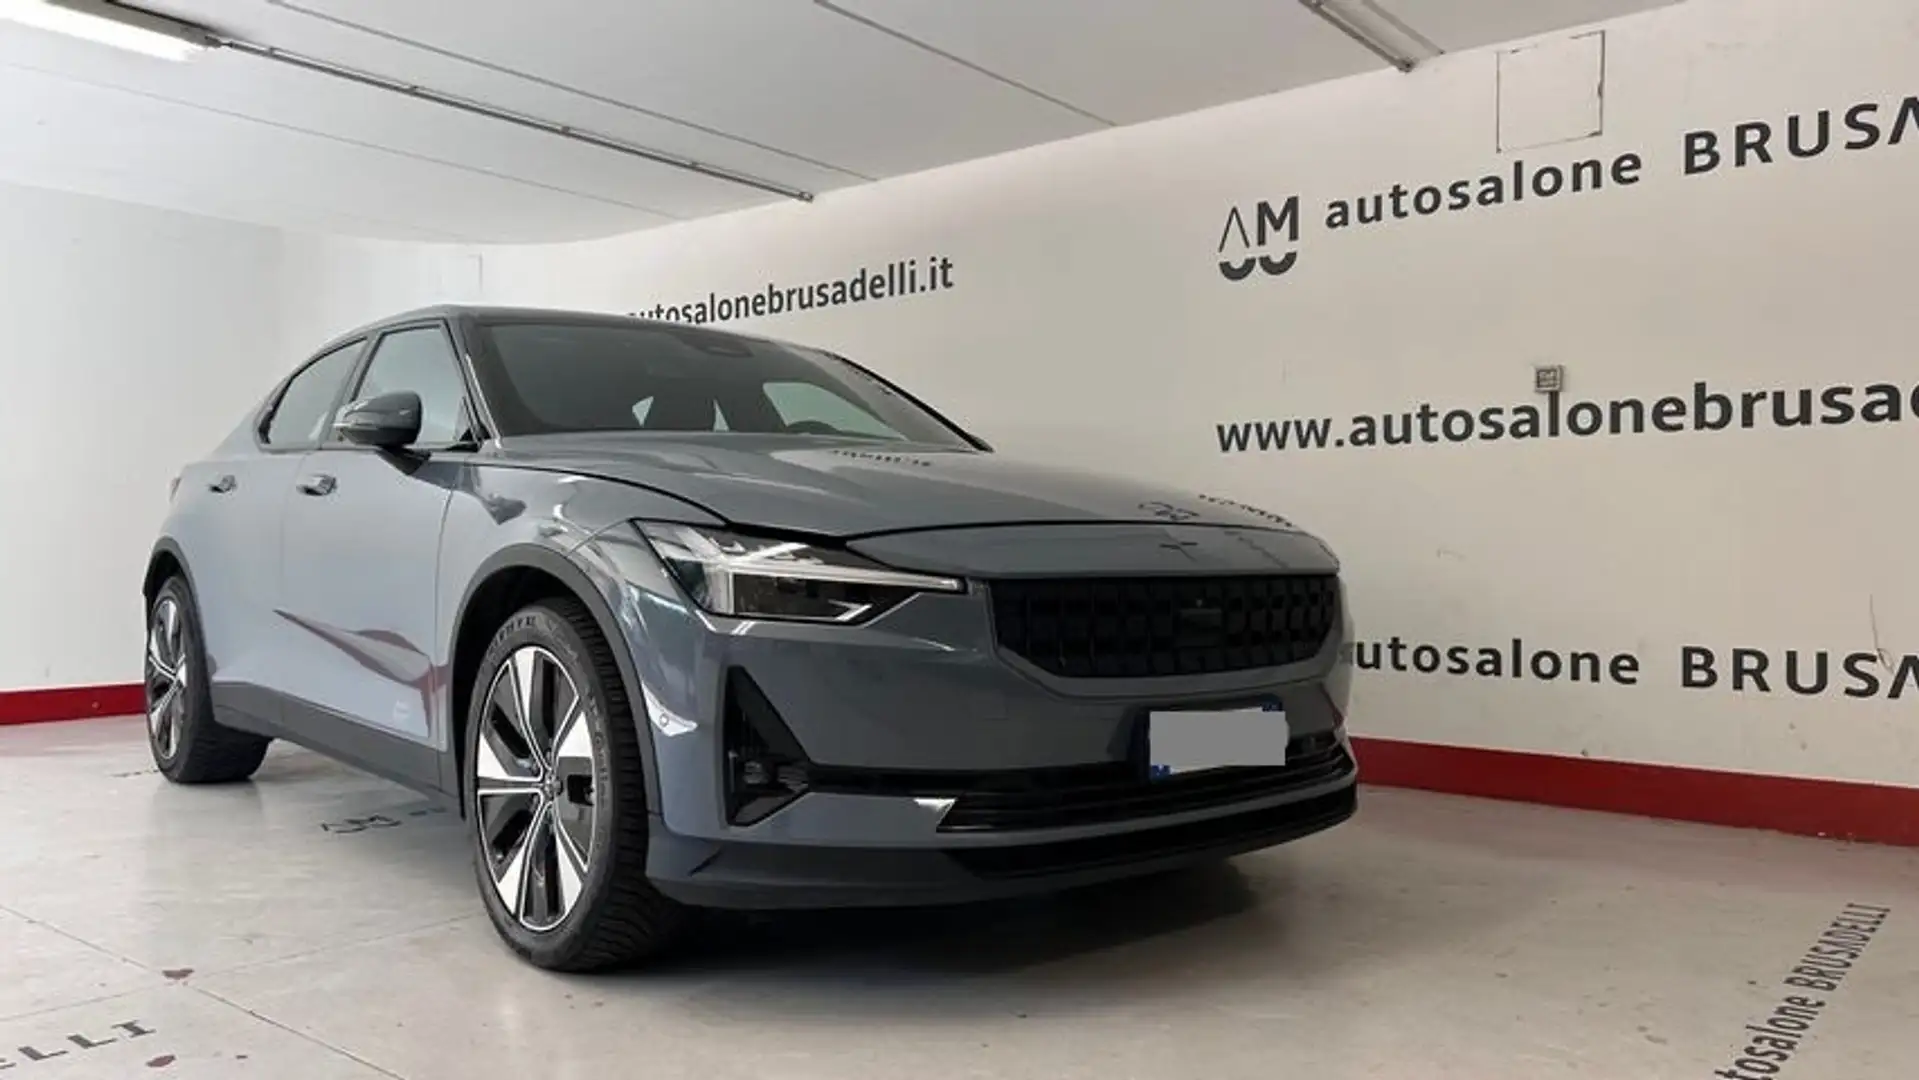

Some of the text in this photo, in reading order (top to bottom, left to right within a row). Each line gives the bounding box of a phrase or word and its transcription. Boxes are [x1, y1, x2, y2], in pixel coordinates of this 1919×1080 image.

[1325, 153, 1642, 229] autosalone
[1684, 96, 1919, 175] BRUSA
[628, 256, 954, 324] tosalonebrusadelli.it
[1216, 381, 1919, 453] www.autosalonebrusa
[1351, 636, 1919, 699] utosalone BRUSA
[1784, 903, 1891, 991] BRUSADELLI
